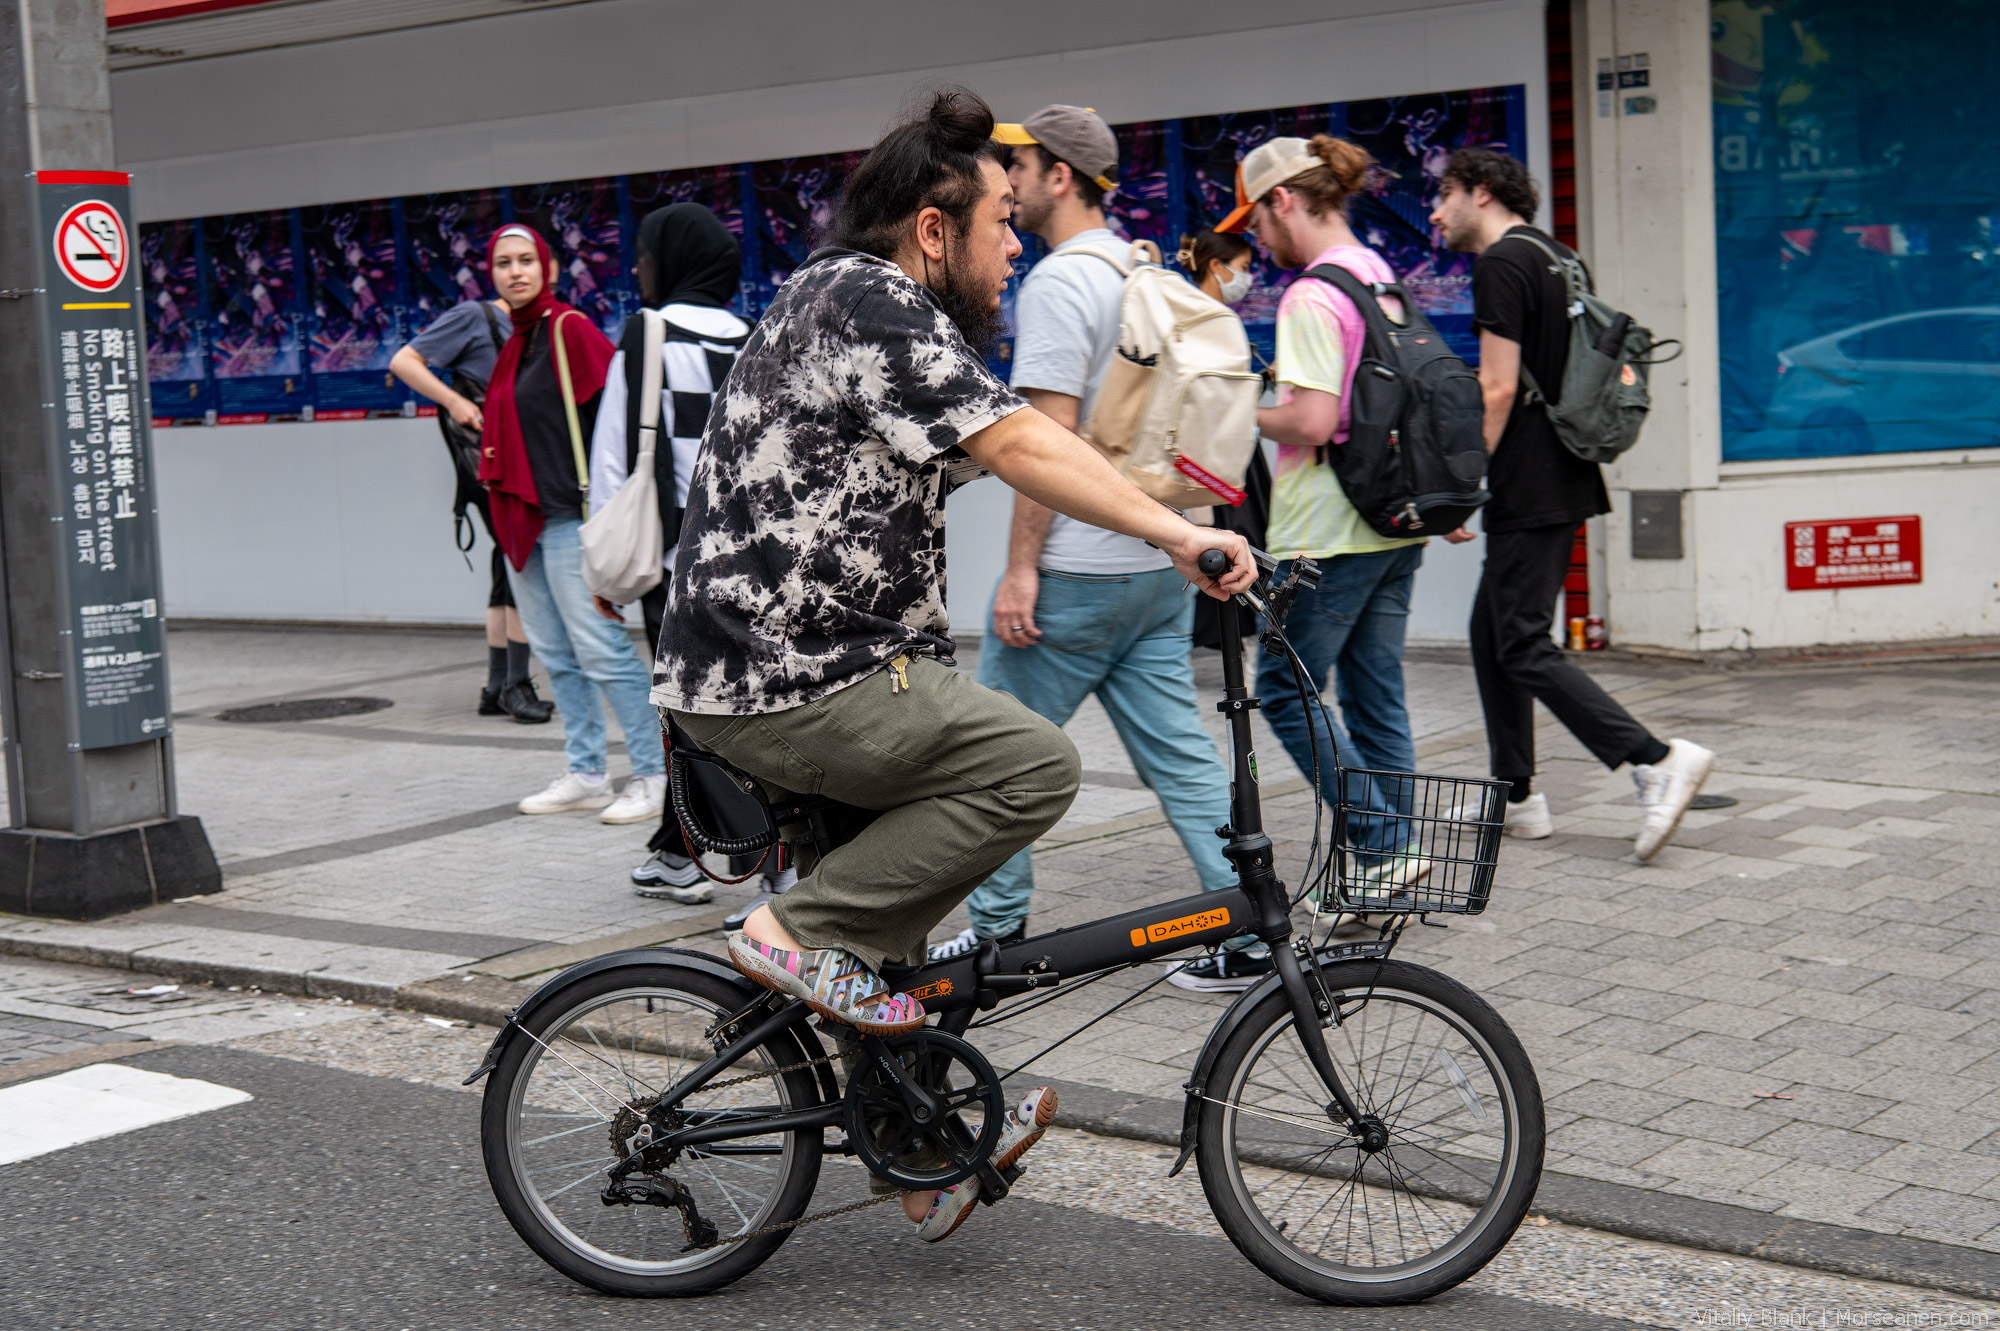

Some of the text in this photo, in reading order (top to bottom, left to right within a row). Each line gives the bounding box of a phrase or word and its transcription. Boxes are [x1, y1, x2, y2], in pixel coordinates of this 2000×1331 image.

[82, 329, 117, 572] No Smoking on the street
[101, 327, 137, 519] 路上喫煙禁止
[68, 439, 96, 564] 노상 흡연 금지
[1154, 913, 1224, 937] DAHON
[879, 1056, 900, 1084] DAHON
